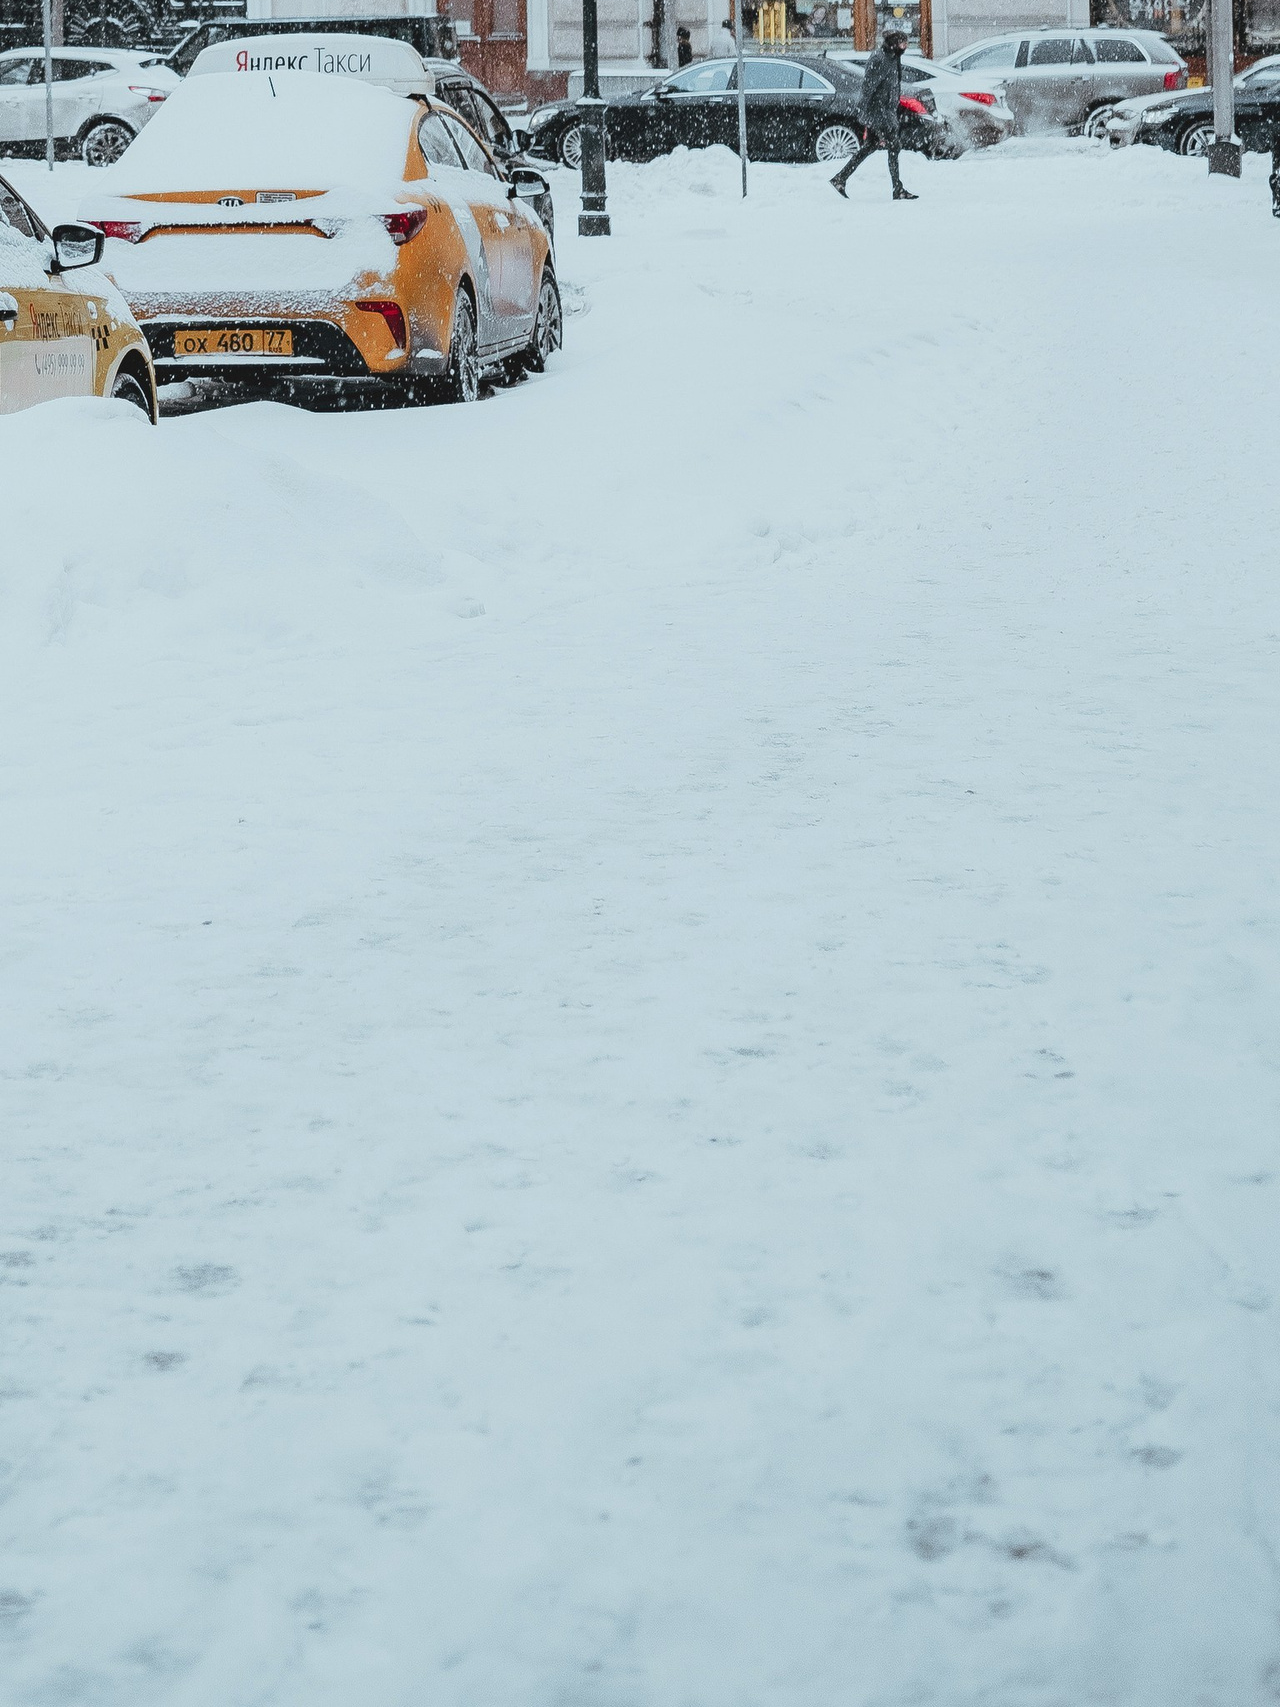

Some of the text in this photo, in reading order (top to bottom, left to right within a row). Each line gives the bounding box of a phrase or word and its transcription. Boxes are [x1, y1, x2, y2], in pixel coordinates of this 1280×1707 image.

[314, 48, 371, 74] Такси
[29, 303, 61, 343] Яндекс
[266, 332, 285, 347] 77
